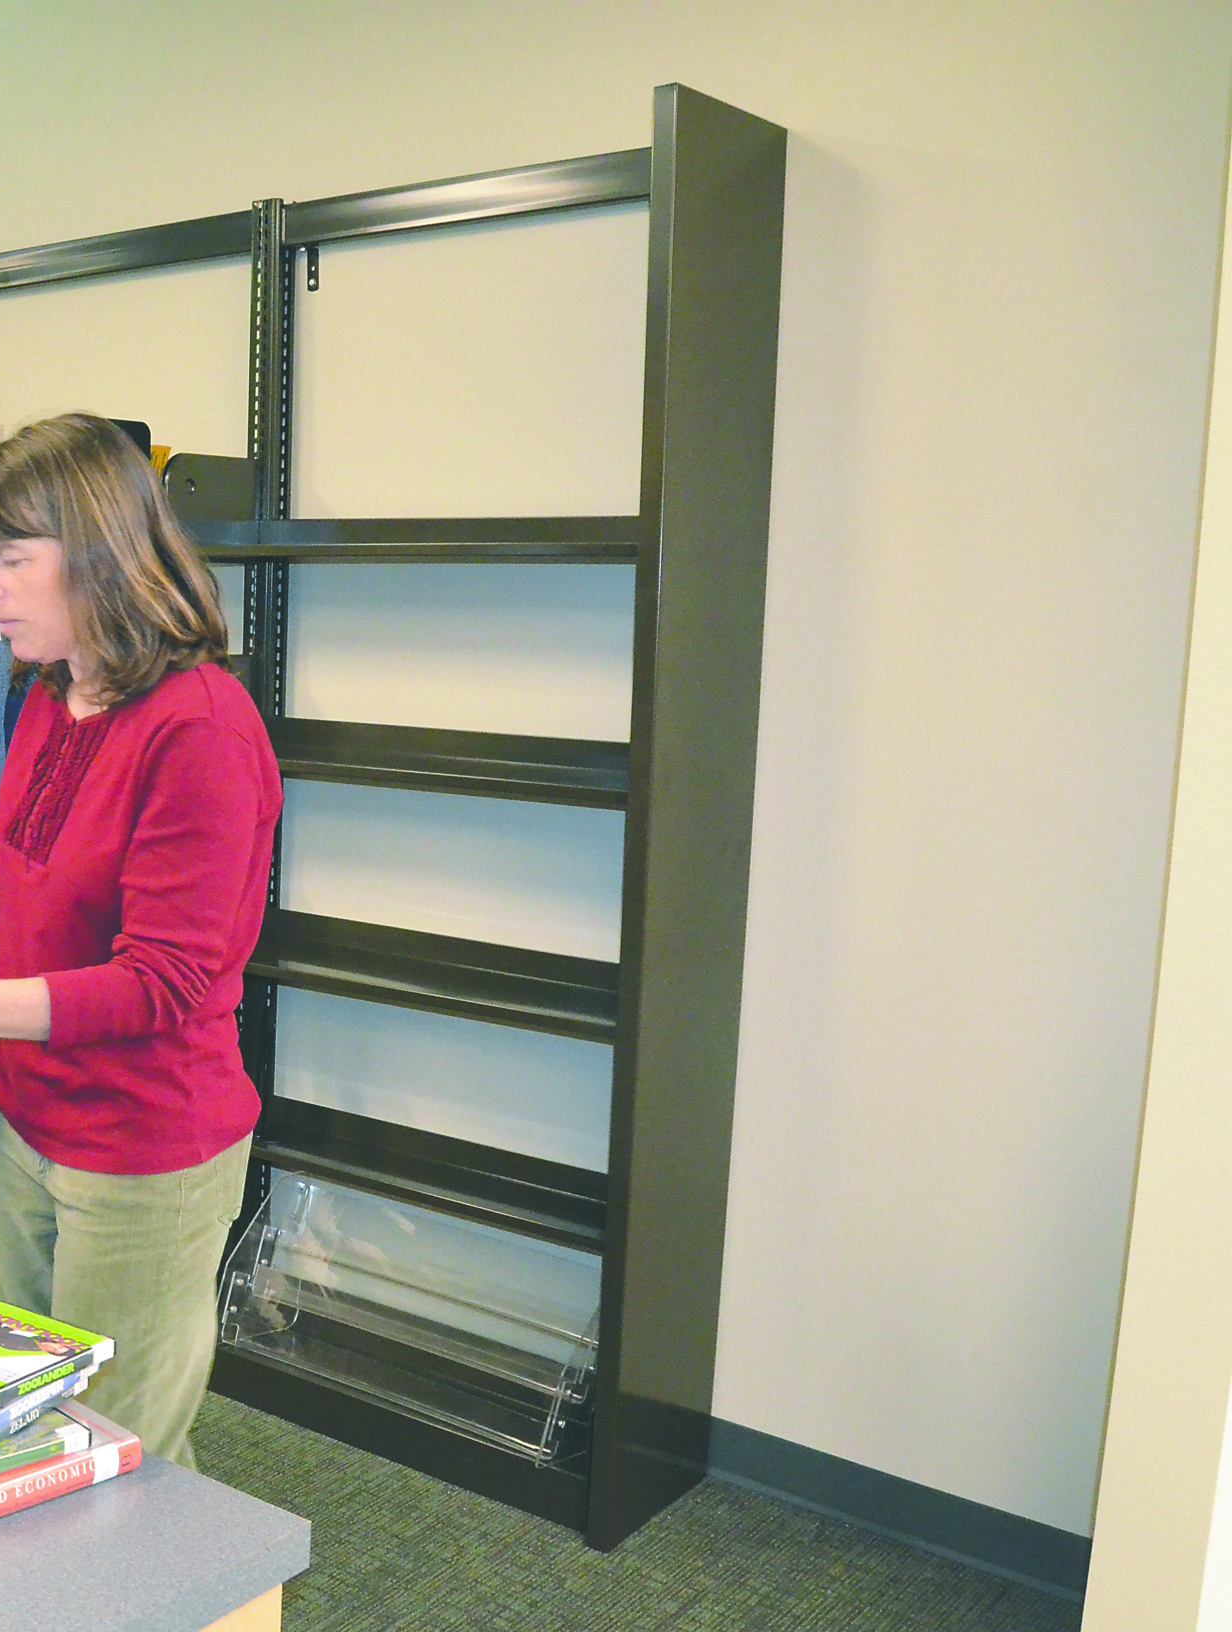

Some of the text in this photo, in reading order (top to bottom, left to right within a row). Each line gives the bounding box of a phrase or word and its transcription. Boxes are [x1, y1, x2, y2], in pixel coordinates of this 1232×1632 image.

[17, 1362, 75, 1395] ZOOLANDER
[8, 1379, 65, 1420] ZOOKEEPER
[9, 1408, 41, 1434] ZELARY
